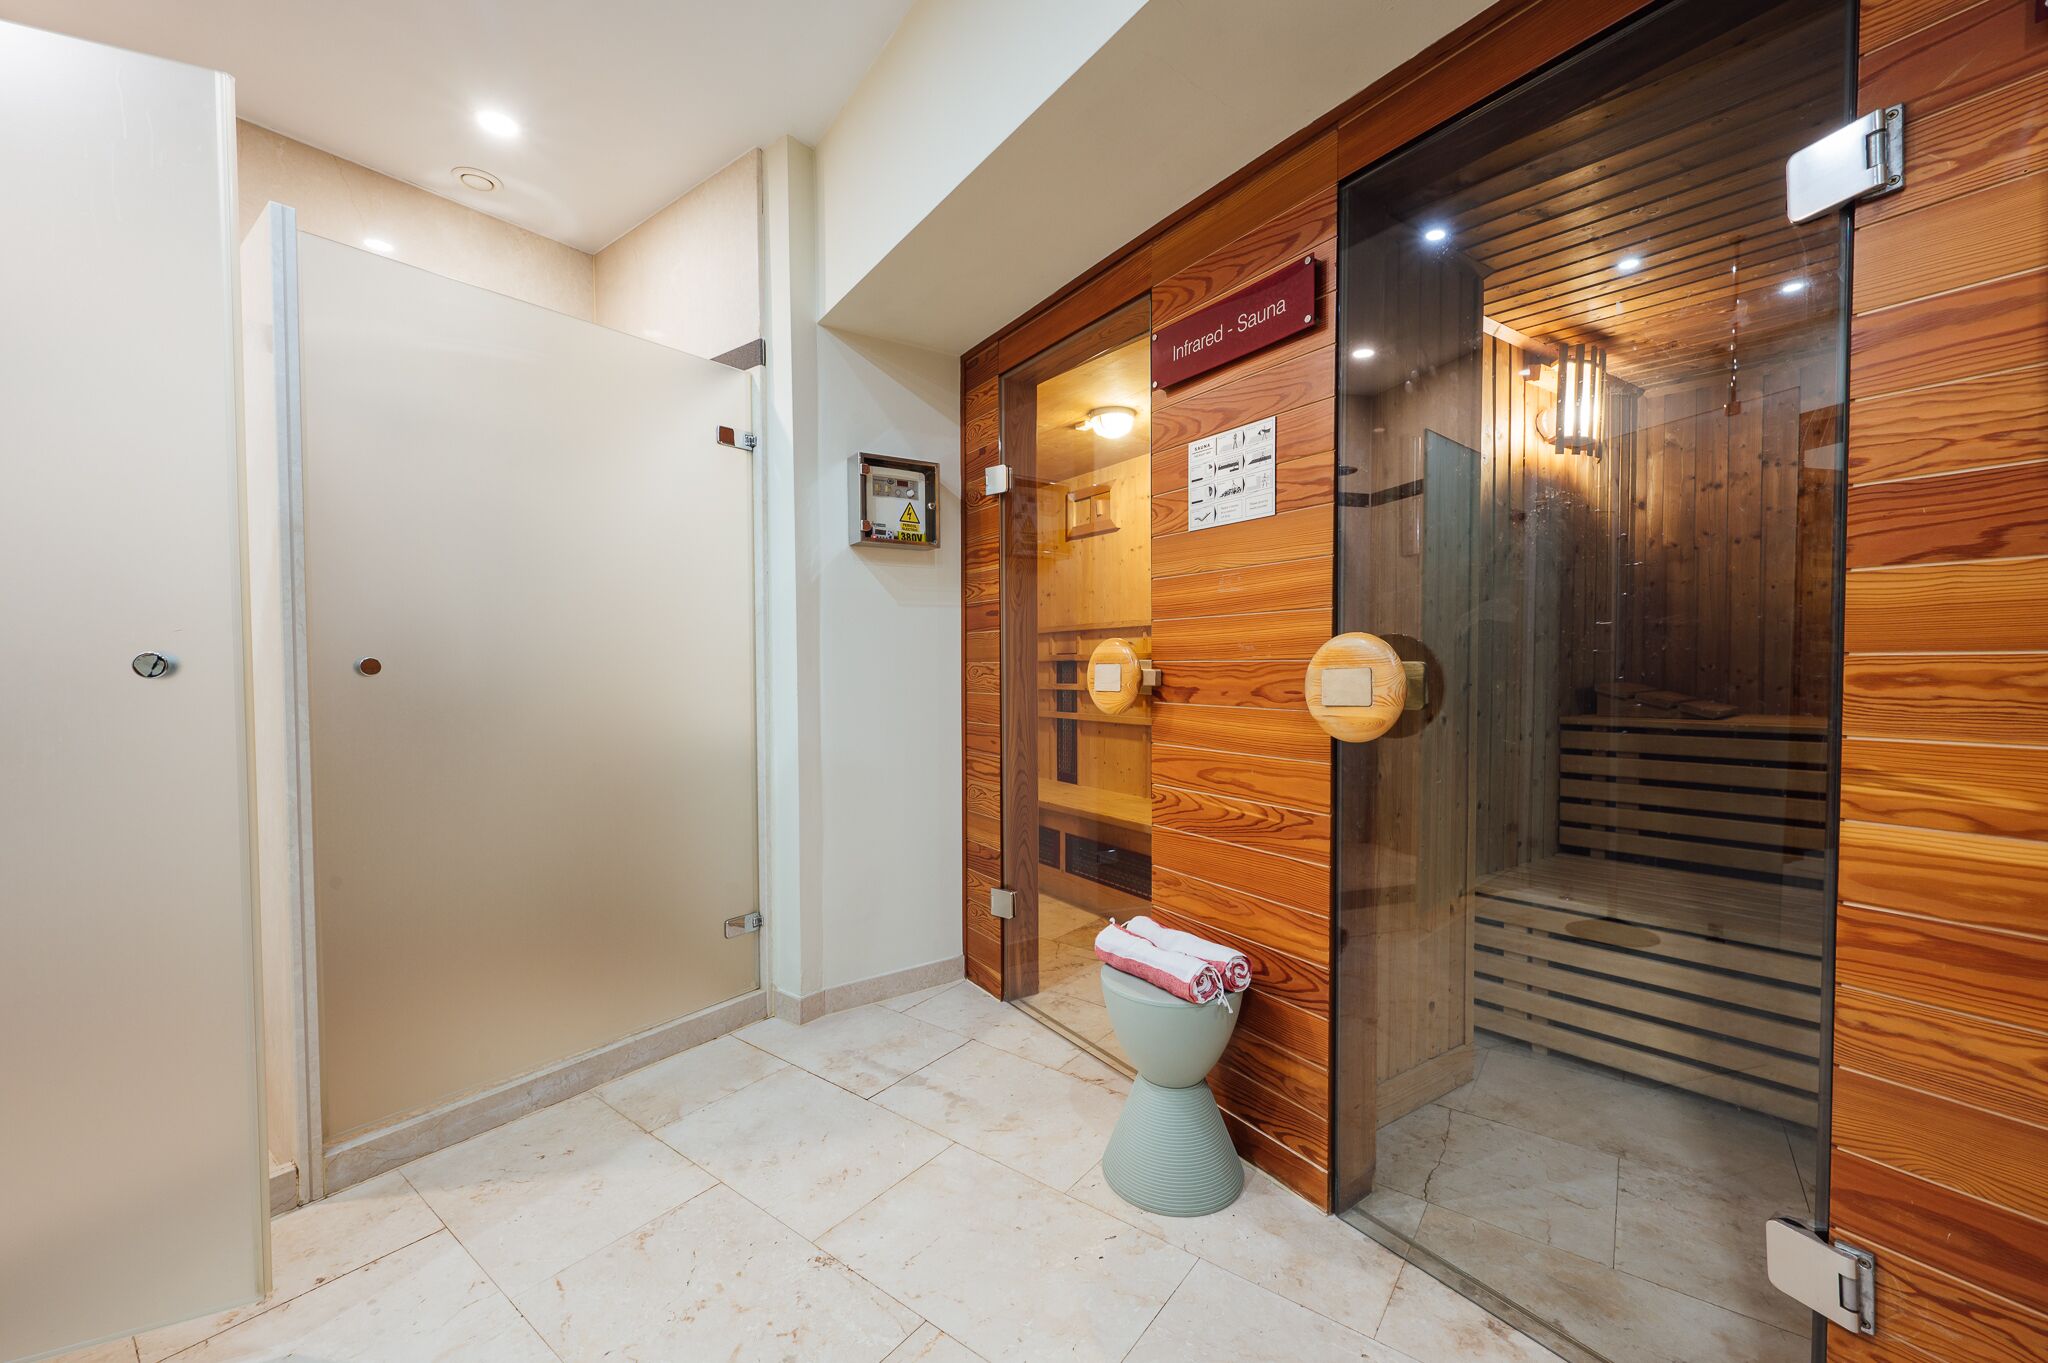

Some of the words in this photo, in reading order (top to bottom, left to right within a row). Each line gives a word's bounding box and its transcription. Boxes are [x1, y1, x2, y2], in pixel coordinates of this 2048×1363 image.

[1173, 324, 1223, 361] Infrared
[1237, 299, 1286, 332] Sauna
[901, 532, 922, 541] 380V
